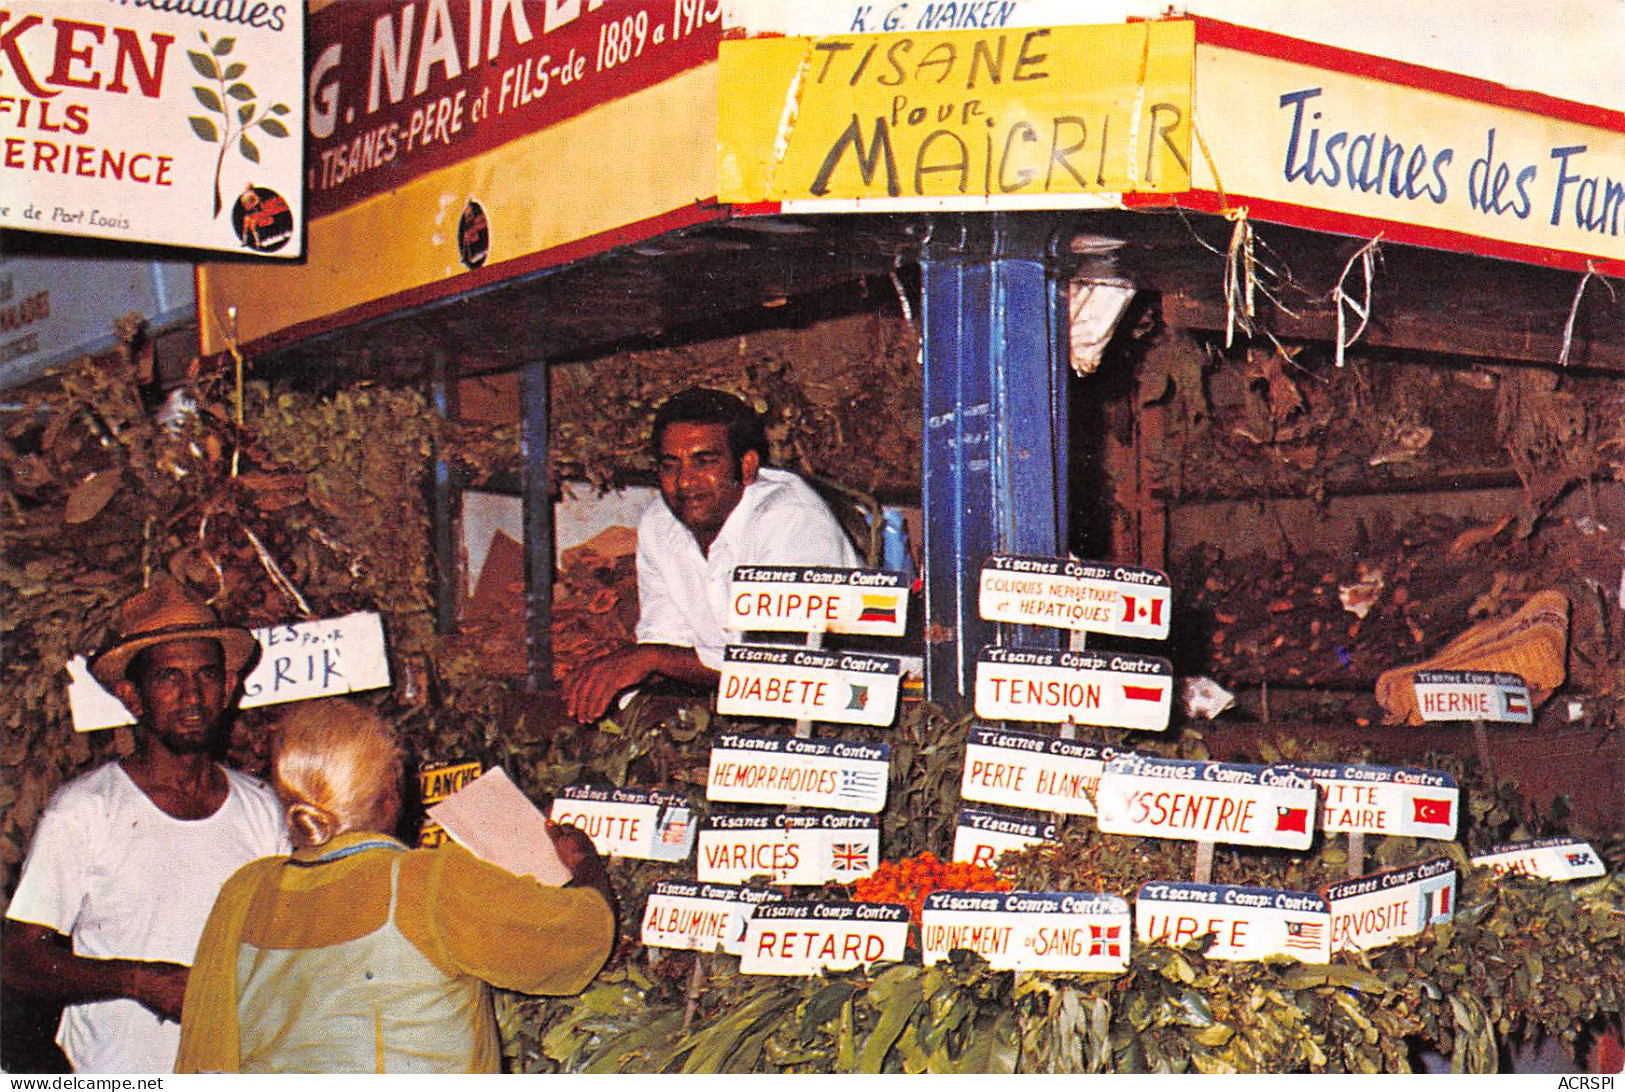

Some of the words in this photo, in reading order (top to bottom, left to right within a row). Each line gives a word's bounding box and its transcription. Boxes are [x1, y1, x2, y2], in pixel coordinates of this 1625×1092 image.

[916, 1, 1017, 29] NAIKEN
[367, 0, 605, 114] NAIK
[471, 87, 489, 123] et
[596, 10, 648, 72] 1889
[814, 29, 1051, 89] TISANE
[4, 138, 174, 186] ERIENCE
[1280, 88, 1454, 205] Tisanes
[1469, 128, 1537, 219] des
[23, 203, 42, 220] de
[52, 206, 84, 224] Port
[737, 568, 797, 582] Tisanes
[849, 571, 898, 586] Contre
[992, 556, 1058, 575] Tisanes
[1114, 568, 1163, 585] Contre
[735, 593, 840, 620] GRIPPE
[1020, 600, 1111, 622] HEPATIQUES
[257, 625, 299, 646] ES
[729, 648, 787, 663] Tisanes
[841, 657, 889, 672] Contre
[988, 649, 1053, 665] Tisanes
[1110, 657, 1160, 673] Contre
[725, 675, 829, 706] DIABETE
[990, 678, 1100, 709] TENSION
[1424, 692, 1490, 713] HERNIE
[721, 735, 779, 751] Tisanes
[833, 744, 882, 760] Contre
[978, 731, 1044, 752] Tisanes
[712, 762, 838, 794] HEMORRHOIDES
[970, 760, 1027, 791] PERTE
[1394, 771, 1443, 787] Contre
[711, 815, 768, 829] Tisanes
[822, 814, 870, 829] Contre
[1105, 790, 1256, 834] YSSENTRIE
[1324, 807, 1386, 829] TAIRE
[970, 815, 1037, 837] Tisanes
[705, 843, 799, 870] VARICES
[1147, 884, 1217, 903] Tisanes
[1275, 894, 1324, 911] Contre
[1327, 879, 1378, 900] Tisanes
[758, 903, 807, 918] Tisanes
[856, 904, 901, 920] Contre
[929, 895, 998, 911] Tisanes
[1061, 896, 1124, 915] Contre
[646, 906, 730, 939] ALBUMINE
[757, 931, 885, 962] RETARD
[926, 925, 1013, 955] URINEMENT
[1034, 927, 1084, 956] SANG
